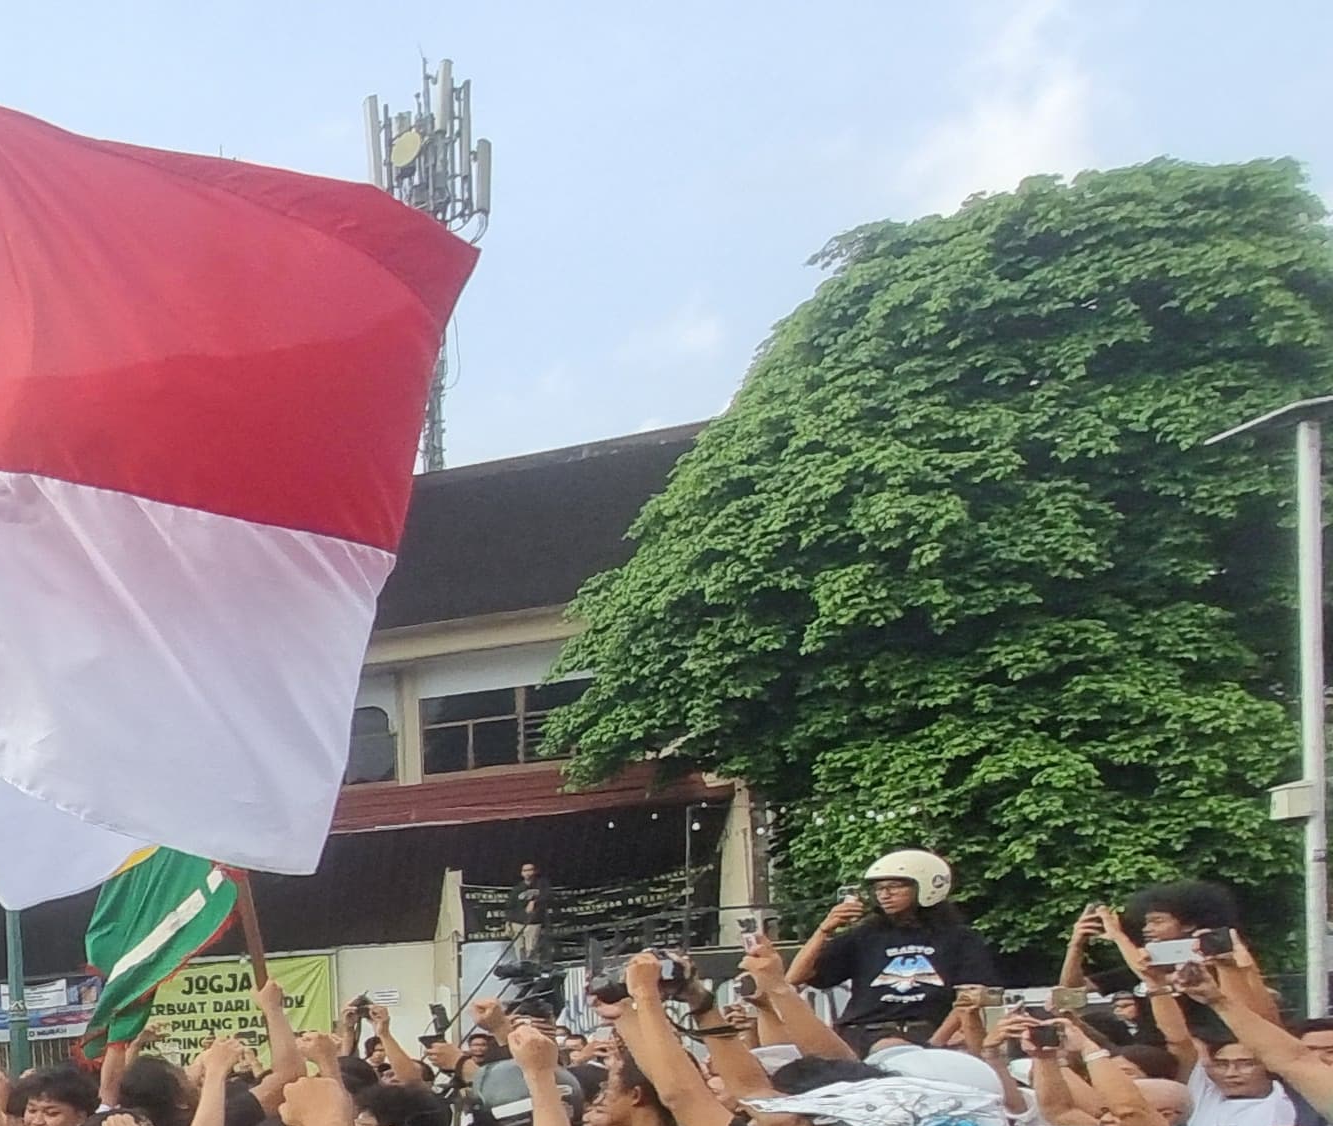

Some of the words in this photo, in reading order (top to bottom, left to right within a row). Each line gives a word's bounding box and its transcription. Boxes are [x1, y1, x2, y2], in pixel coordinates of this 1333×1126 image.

[181, 972, 252, 995] JOGJA
[150, 1001, 206, 1016] ERBUAT
[213, 999, 250, 1012] DARI
[172, 1017, 232, 1032] PULANG
